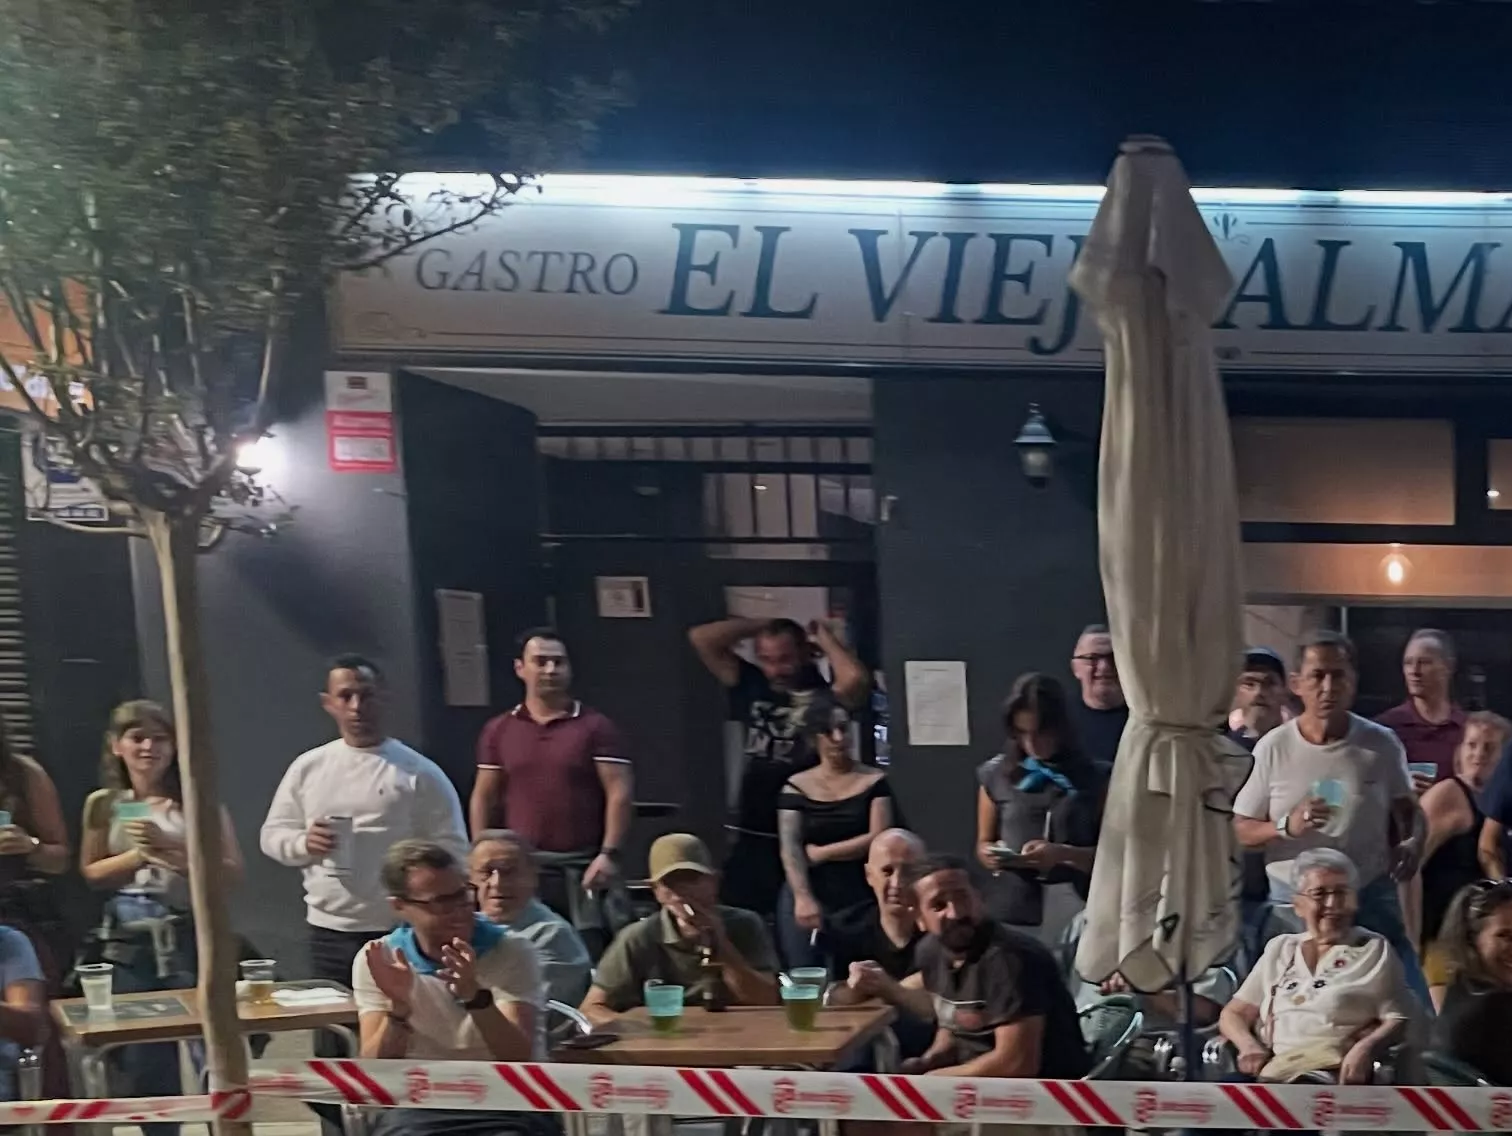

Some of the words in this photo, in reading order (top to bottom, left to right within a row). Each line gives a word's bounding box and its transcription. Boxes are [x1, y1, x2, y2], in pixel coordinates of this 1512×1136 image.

[416, 247, 639, 296] GASTRO
[656, 222, 819, 319] EL
[847, 228, 1088, 356] VIEJ
